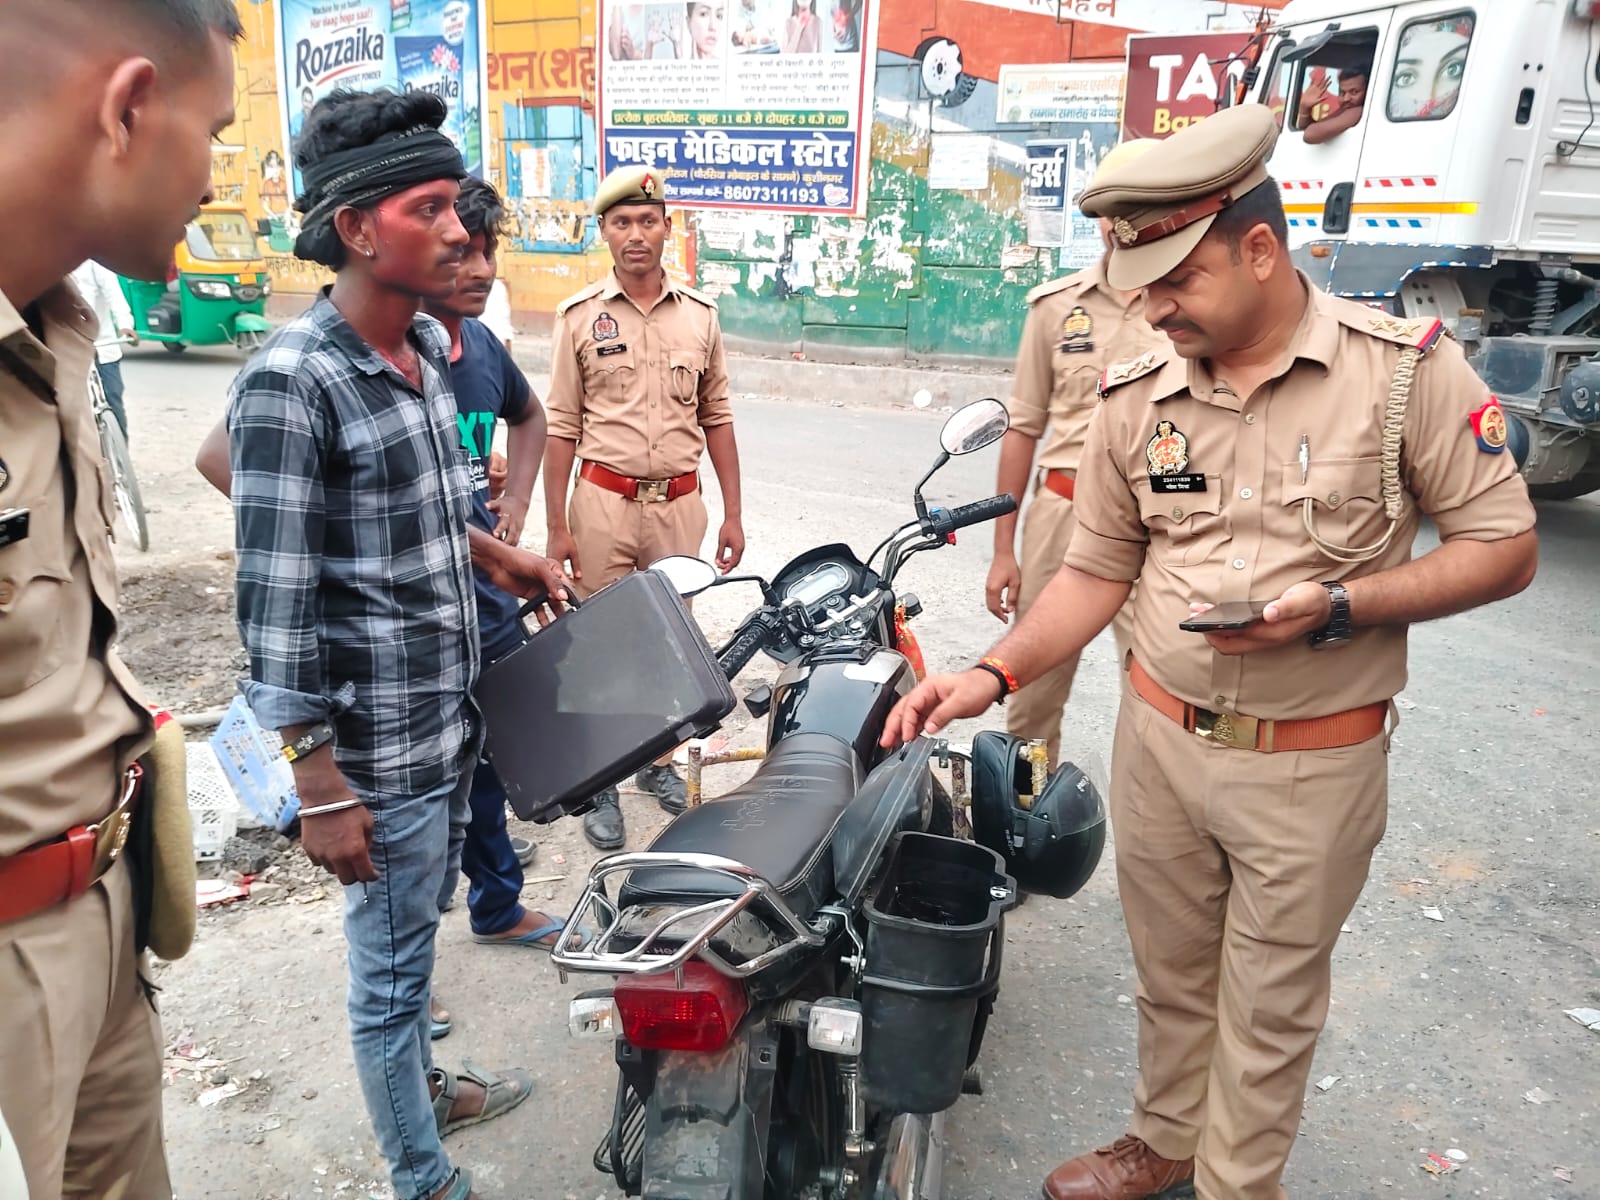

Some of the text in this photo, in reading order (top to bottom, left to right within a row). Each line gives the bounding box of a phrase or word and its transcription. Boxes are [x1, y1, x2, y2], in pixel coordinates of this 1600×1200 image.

[296, 26, 384, 89] Rozzaika
[722, 113, 732, 124] 11
[736, 111, 751, 124] बजे
[766, 111, 797, 126] दोपहर
[808, 111, 825, 125] बजे
[827, 114, 846, 125] तक
[606, 130, 852, 168] फाइन मेडिकल स्टोर
[723, 185, 819, 204] 8607311193
